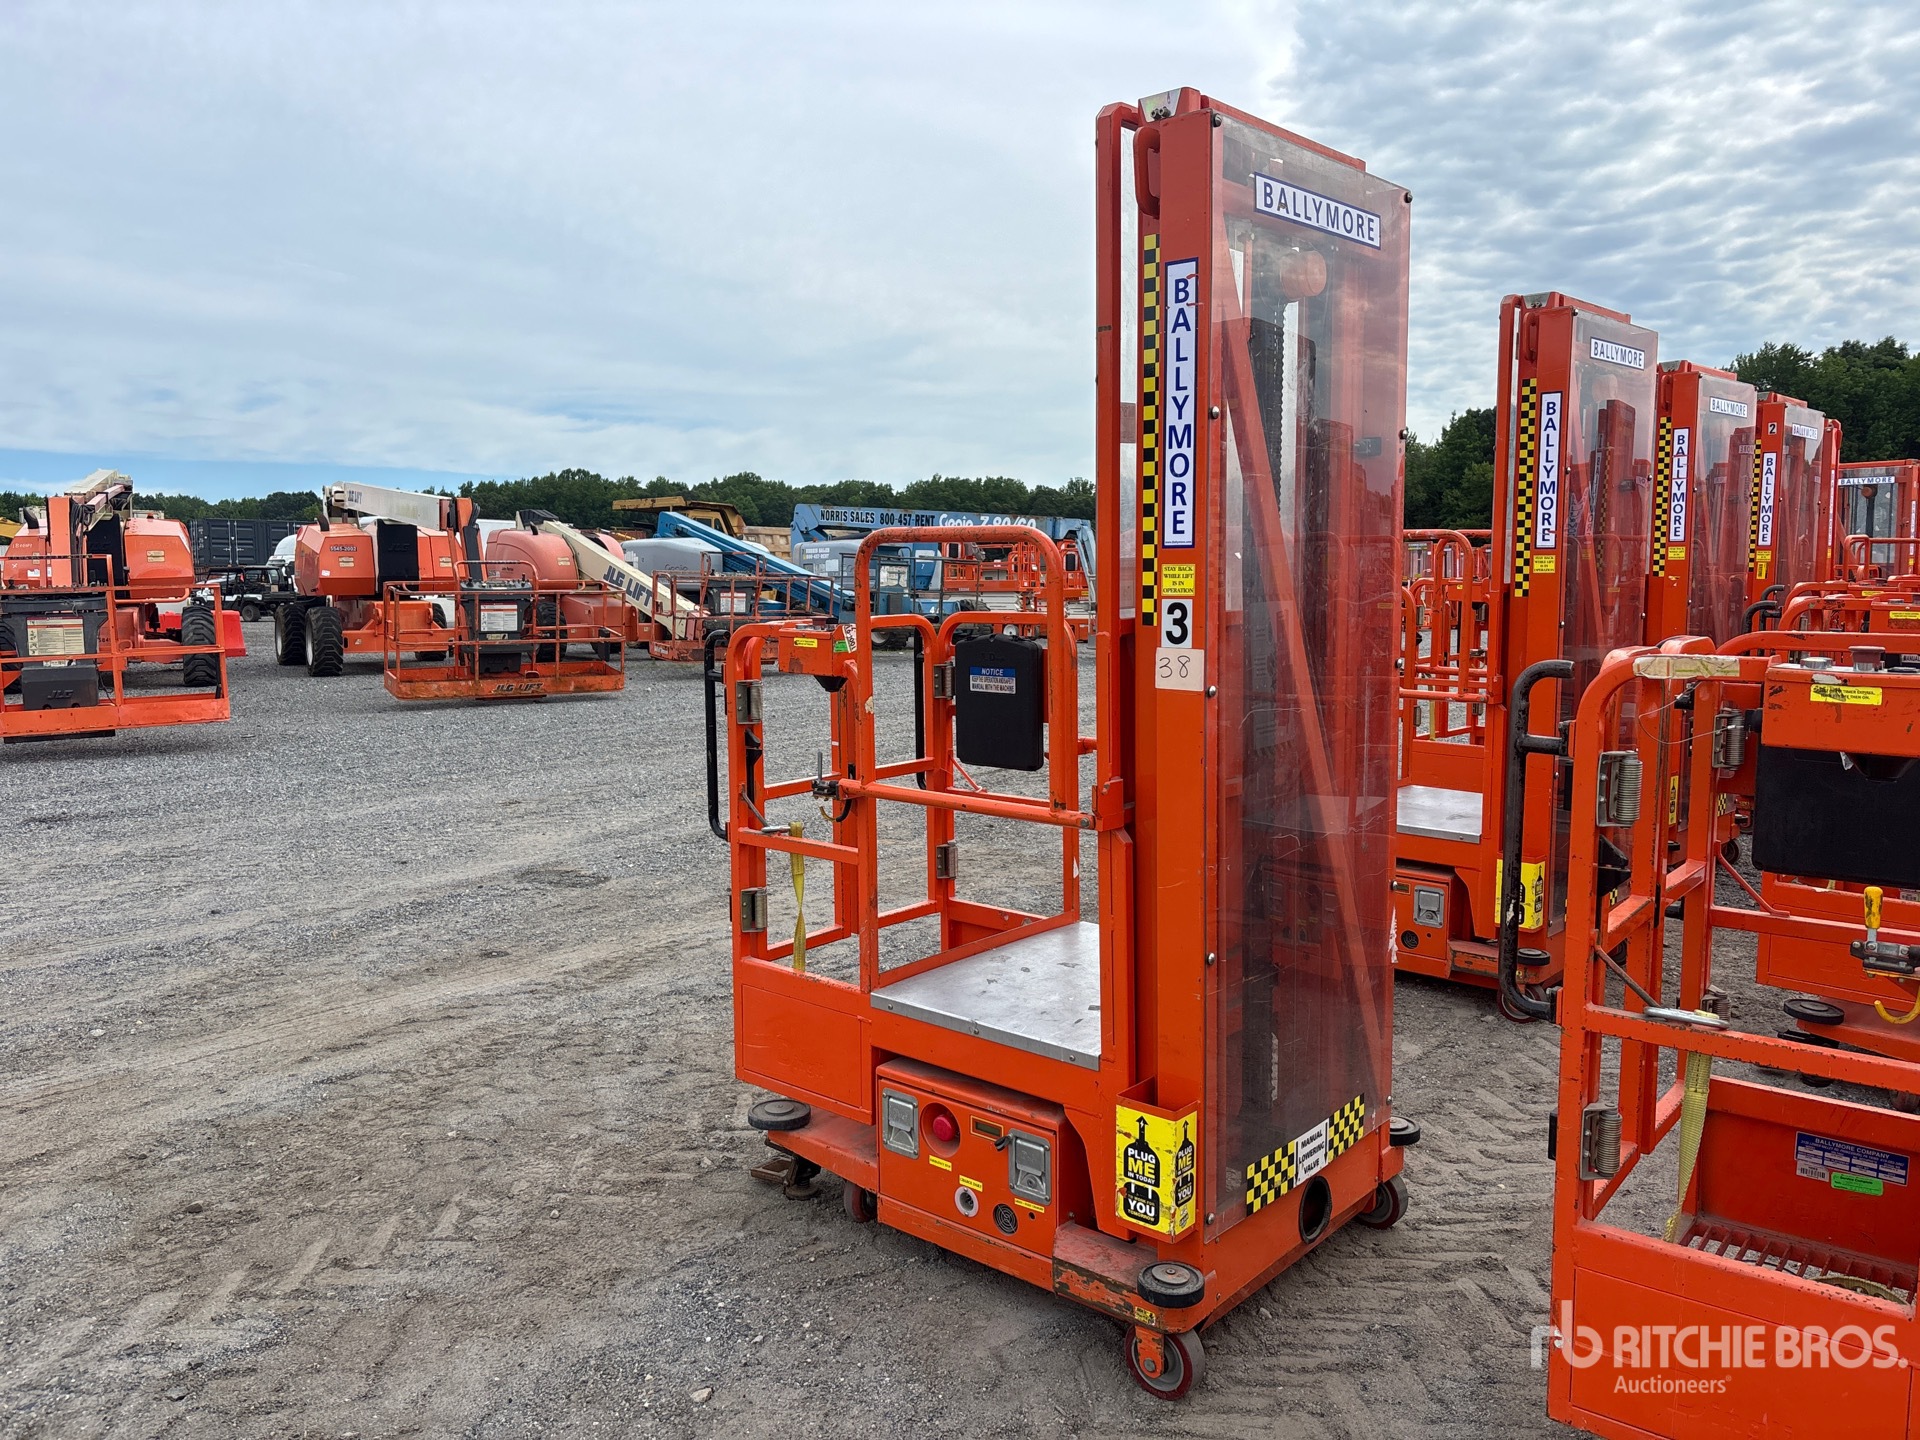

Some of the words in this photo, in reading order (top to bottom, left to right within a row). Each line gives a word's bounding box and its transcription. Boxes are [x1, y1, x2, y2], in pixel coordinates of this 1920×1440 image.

[1263, 181, 1375, 242] BALLYMORE
[1593, 341, 1642, 367] BALLYMORE
[1168, 278, 1192, 535] BALLYMORE
[1712, 399, 1746, 416] BALLYMORE
[1769, 423, 1776, 434] 2
[1540, 401, 1557, 542] BALLYMORE
[1840, 476, 1893, 485] BALLYMORE
[1673, 434, 1686, 537] BALLYMORE
[1761, 457, 1774, 542] BALLYMORE
[820, 509, 848, 522] NORRIS
[850, 511, 875, 524] SALES
[879, 512, 935, 527] 800-457-RENT
[603, 565, 625, 588] JLG
[625, 578, 653, 607] LIFT
[1165, 602, 1188, 645] 3
[981, 667, 1004, 676] NOTICE
[1159, 655, 1191, 678] 38
[48, 690, 73, 700] JLG
[494, 684, 515, 692] JLG
[517, 683, 543, 692] LIFT
[1301, 1130, 1322, 1149] MANUAL
[1127, 1147, 1156, 1164] PLUG
[1178, 1145, 1192, 1158] PLUG
[1299, 1141, 1325, 1164] LOWERING
[1815, 1138, 1855, 1152] BALLYMORE
[1856, 1147, 1890, 1160] COMPANY
[1128, 1157, 1155, 1179] ME
[1178, 1153, 1192, 1170] ME
[1304, 1158, 1320, 1174] VALVE
[1136, 1174, 1155, 1184] TODAY
[1178, 1186, 1192, 1200] YOU
[1127, 1209, 1155, 1221] TOMORROW
[1128, 1198, 1155, 1216] YOU
